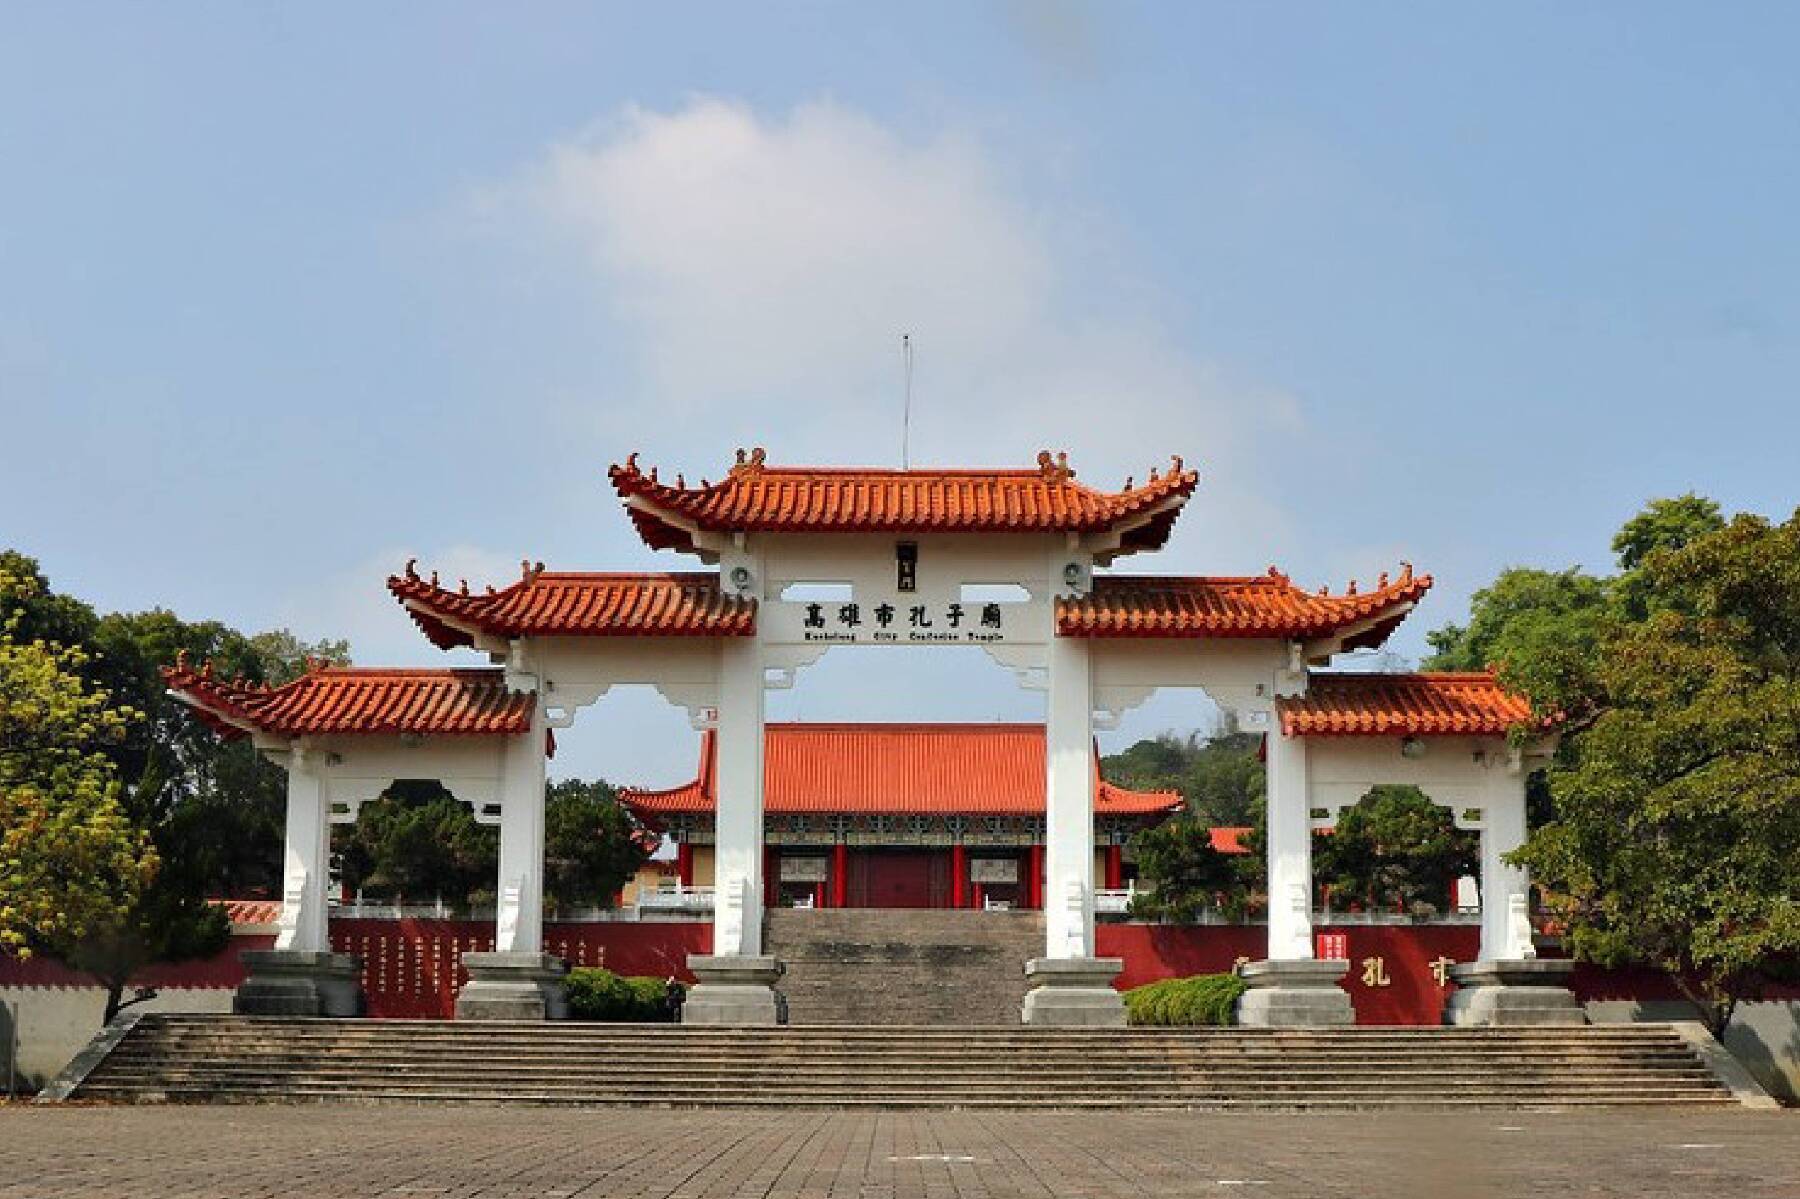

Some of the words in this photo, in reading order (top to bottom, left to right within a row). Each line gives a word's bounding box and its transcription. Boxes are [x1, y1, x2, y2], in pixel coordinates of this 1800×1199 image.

[803, 603, 1001, 628] 高雄市孔子廟
